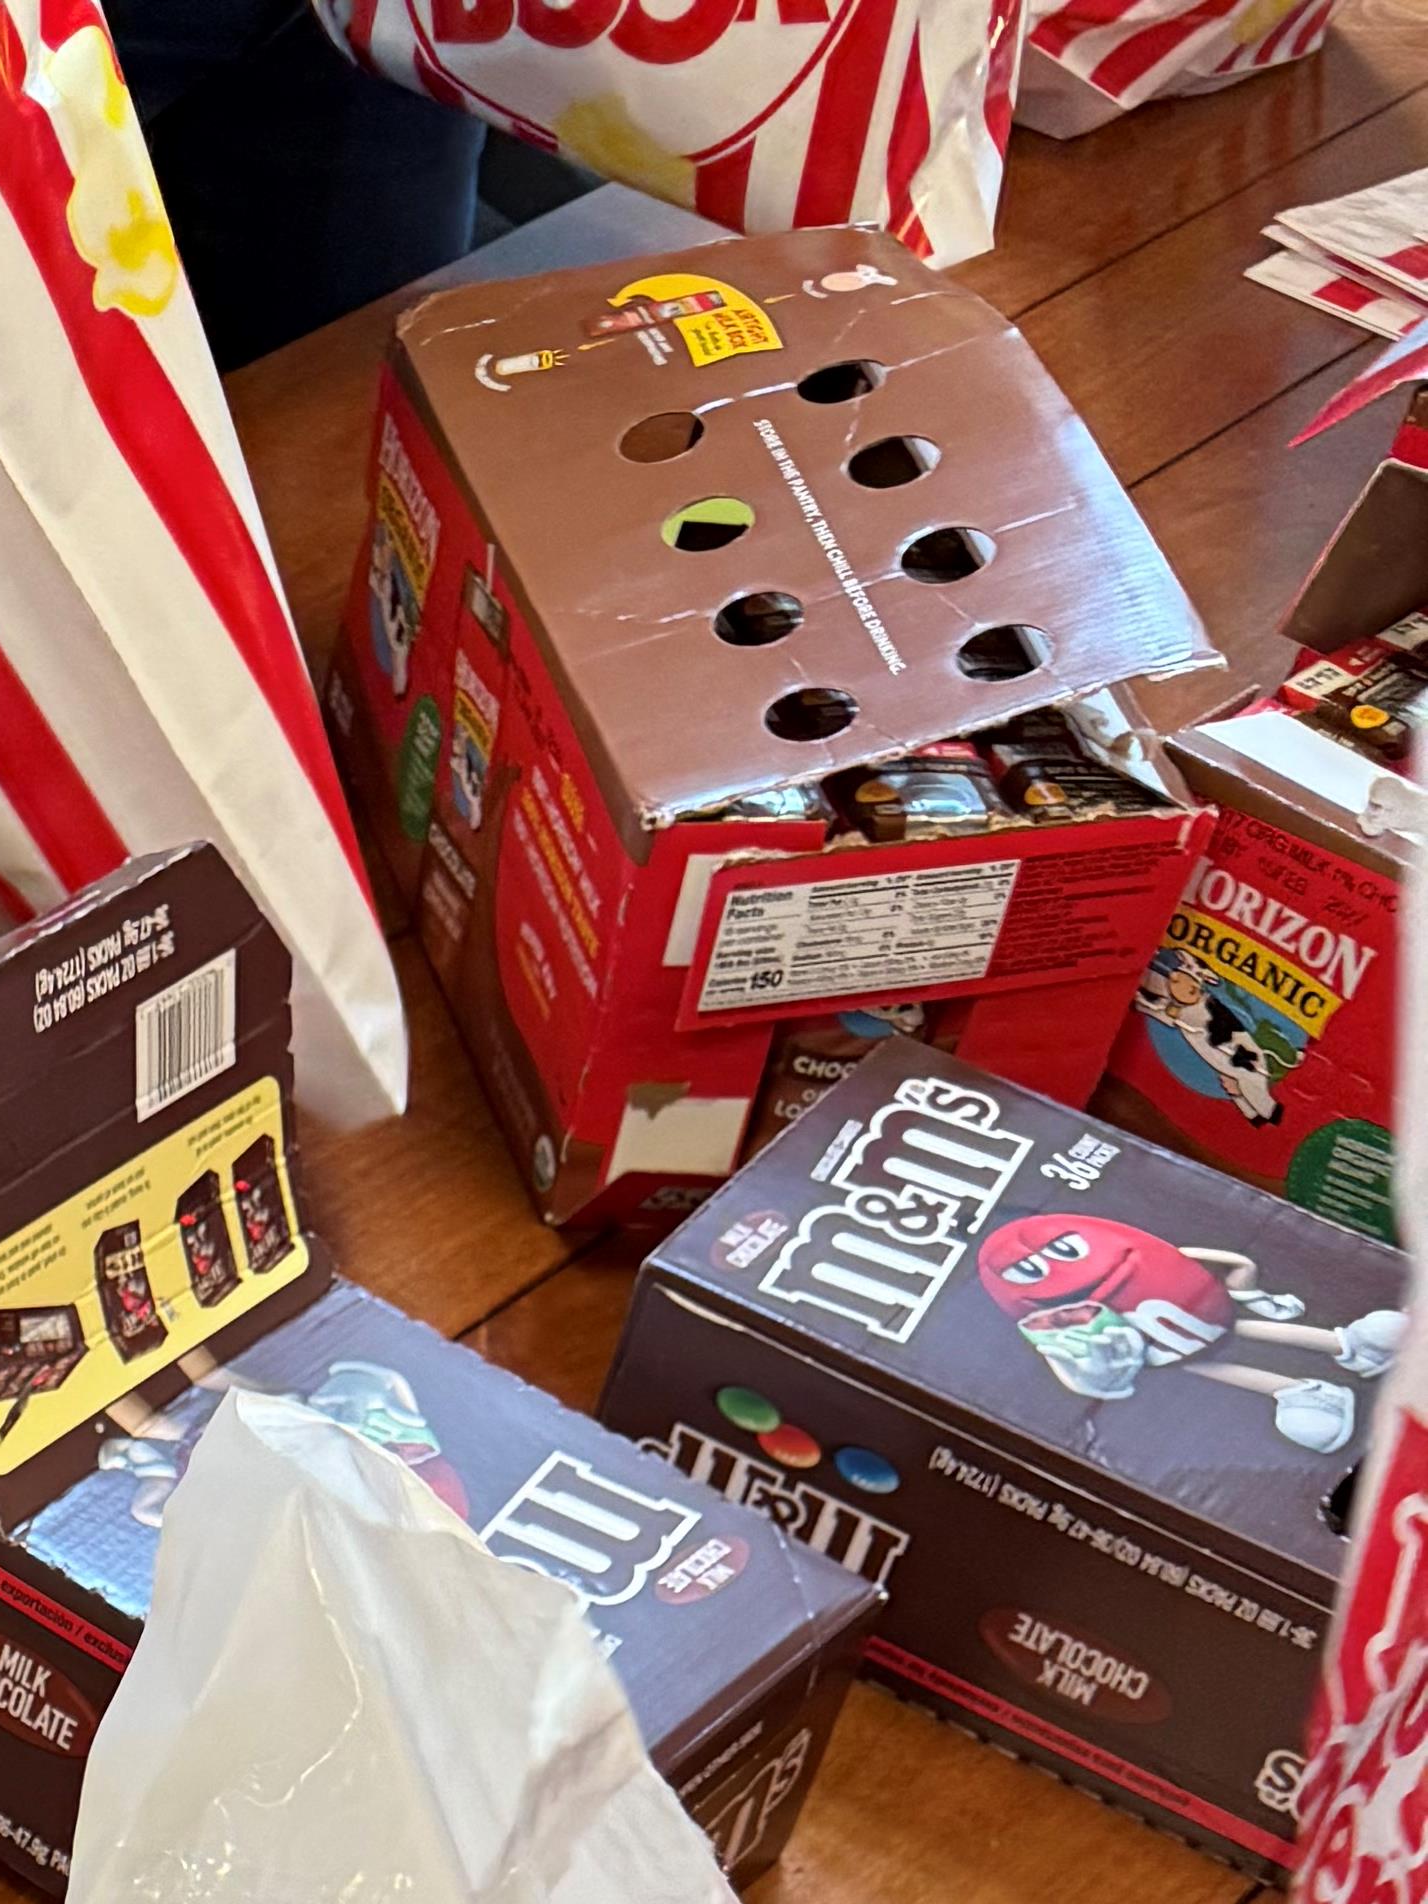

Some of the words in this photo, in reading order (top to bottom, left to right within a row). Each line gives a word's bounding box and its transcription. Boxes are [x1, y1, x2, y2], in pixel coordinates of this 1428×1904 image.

[825, 548, 854, 587] CHILL
[725, 905, 765, 921] Facts
[730, 889, 795, 908] Nutrition
[88, 931, 122, 969] PACKS
[1167, 914, 1327, 1020] ORGANIC
[87, 965, 122, 1003] PACKS
[1040, 1152, 1101, 1192] 36
[1007, 1612, 1150, 1701] CHOCOLATE
[1036, 1659, 1099, 1706] MILK
